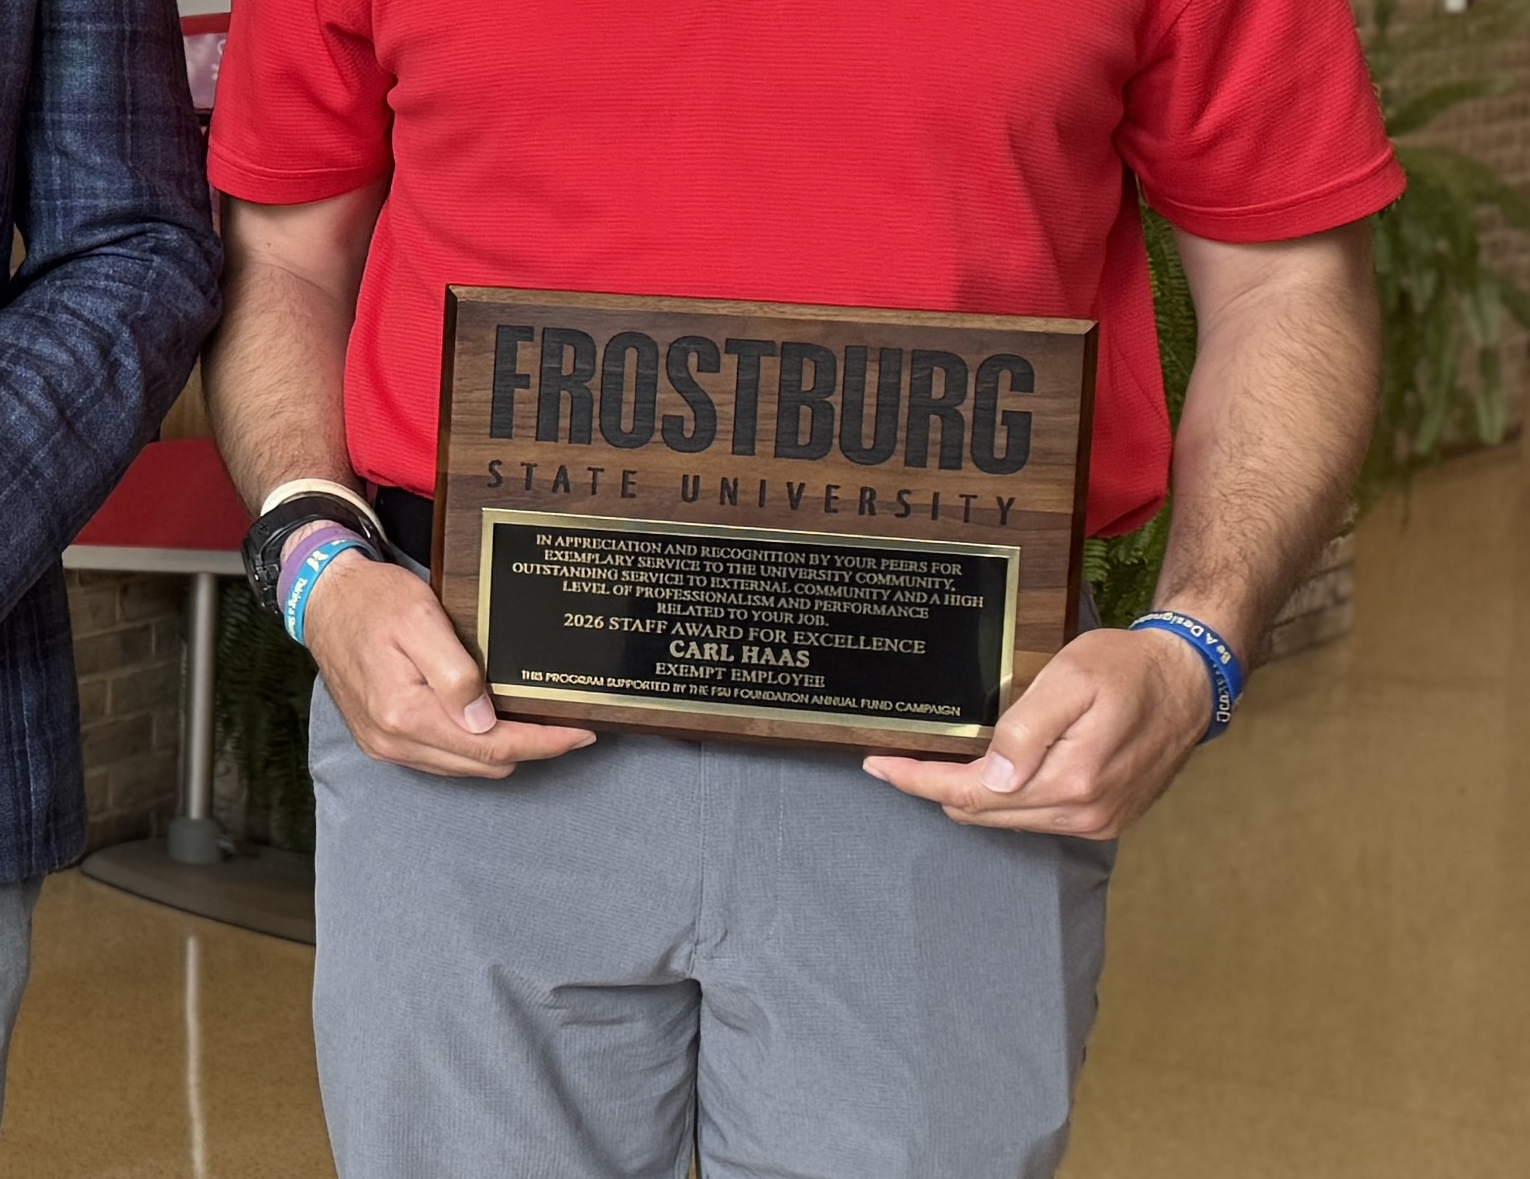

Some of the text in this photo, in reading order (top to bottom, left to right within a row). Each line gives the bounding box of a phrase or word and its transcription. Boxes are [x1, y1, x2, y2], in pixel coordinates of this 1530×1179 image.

[489, 324, 1037, 475] FROSTBURG
[486, 459, 1017, 527] STATE UNIVERSITY
[563, 612, 926, 655] 2026 STAFF AWARD FOR EXCELLENCE
[668, 638, 810, 668] CARL HAAS
[654, 661, 826, 688] EXEMPT EMPLOYEE
